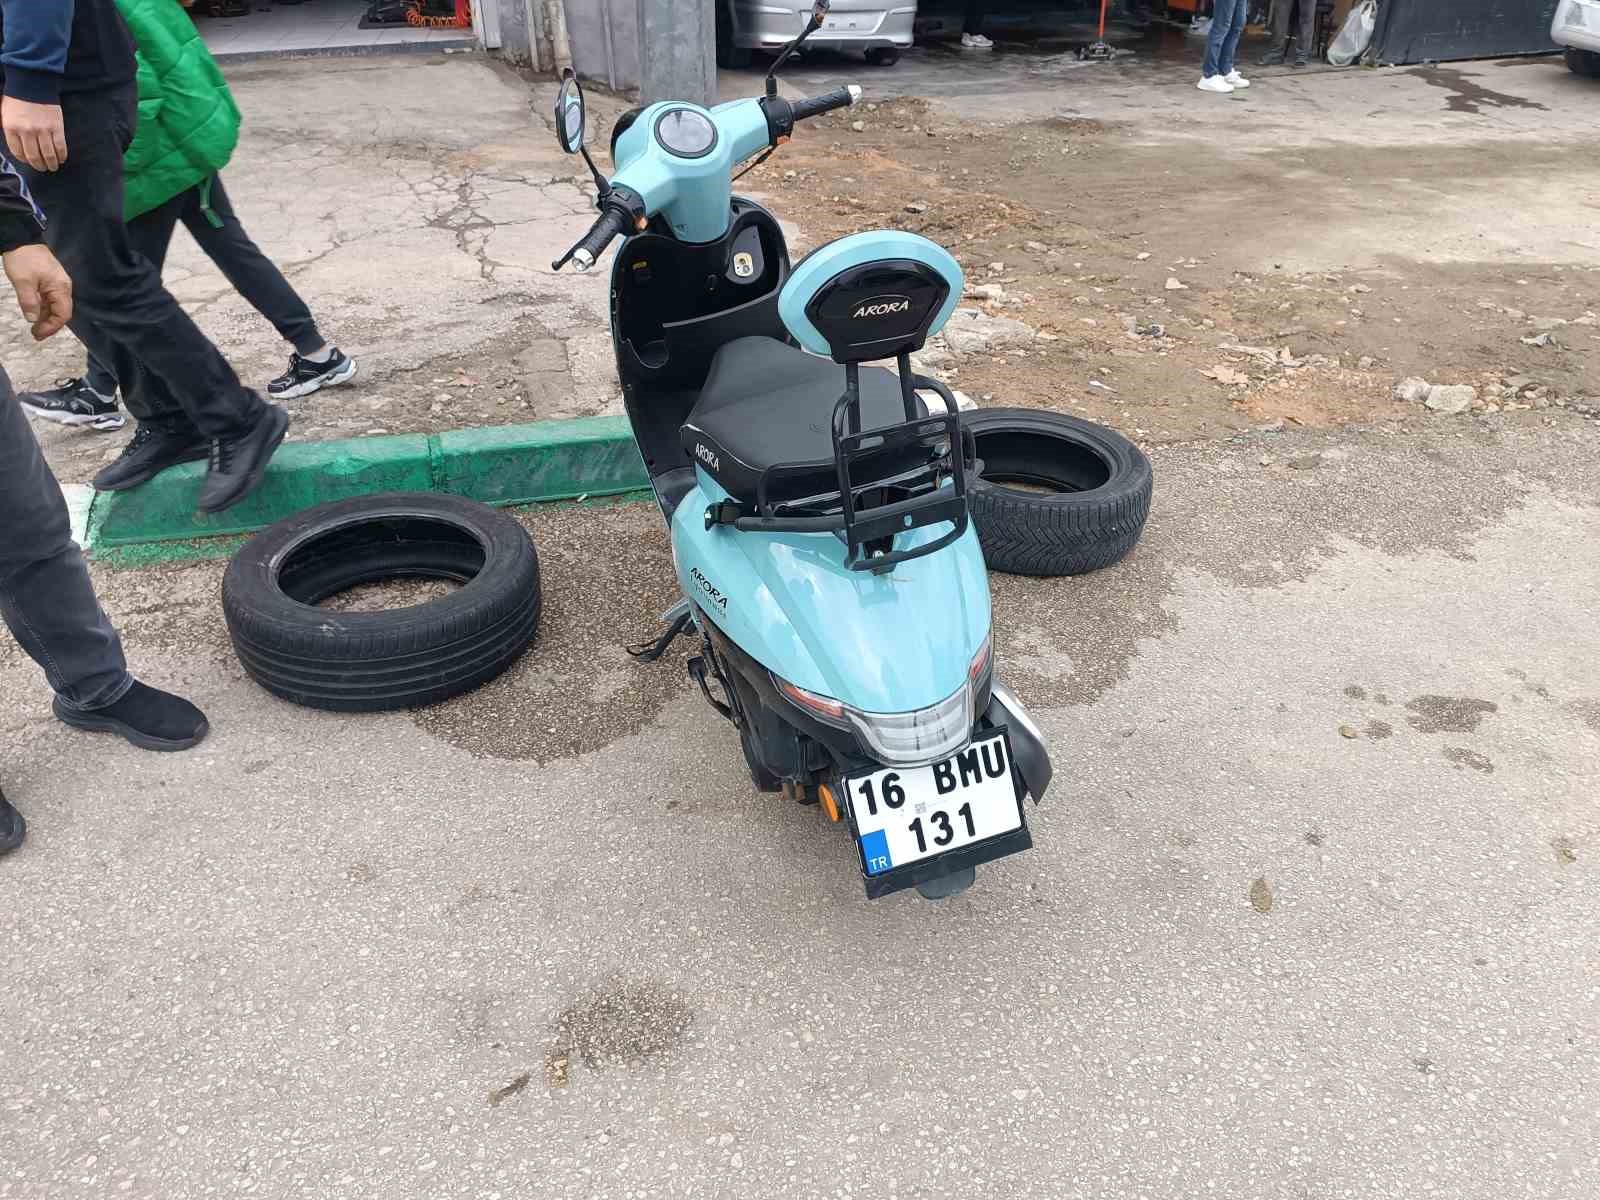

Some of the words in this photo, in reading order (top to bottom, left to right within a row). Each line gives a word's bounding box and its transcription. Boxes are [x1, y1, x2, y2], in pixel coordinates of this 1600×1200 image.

[853, 299, 909, 319] ARORA
[695, 443, 720, 471] ARORA
[690, 567, 728, 608] ARORA
[859, 773, 905, 815] 16
[932, 741, 1006, 794] BMU
[908, 802, 976, 852] 131
[869, 856, 888, 871] TR
